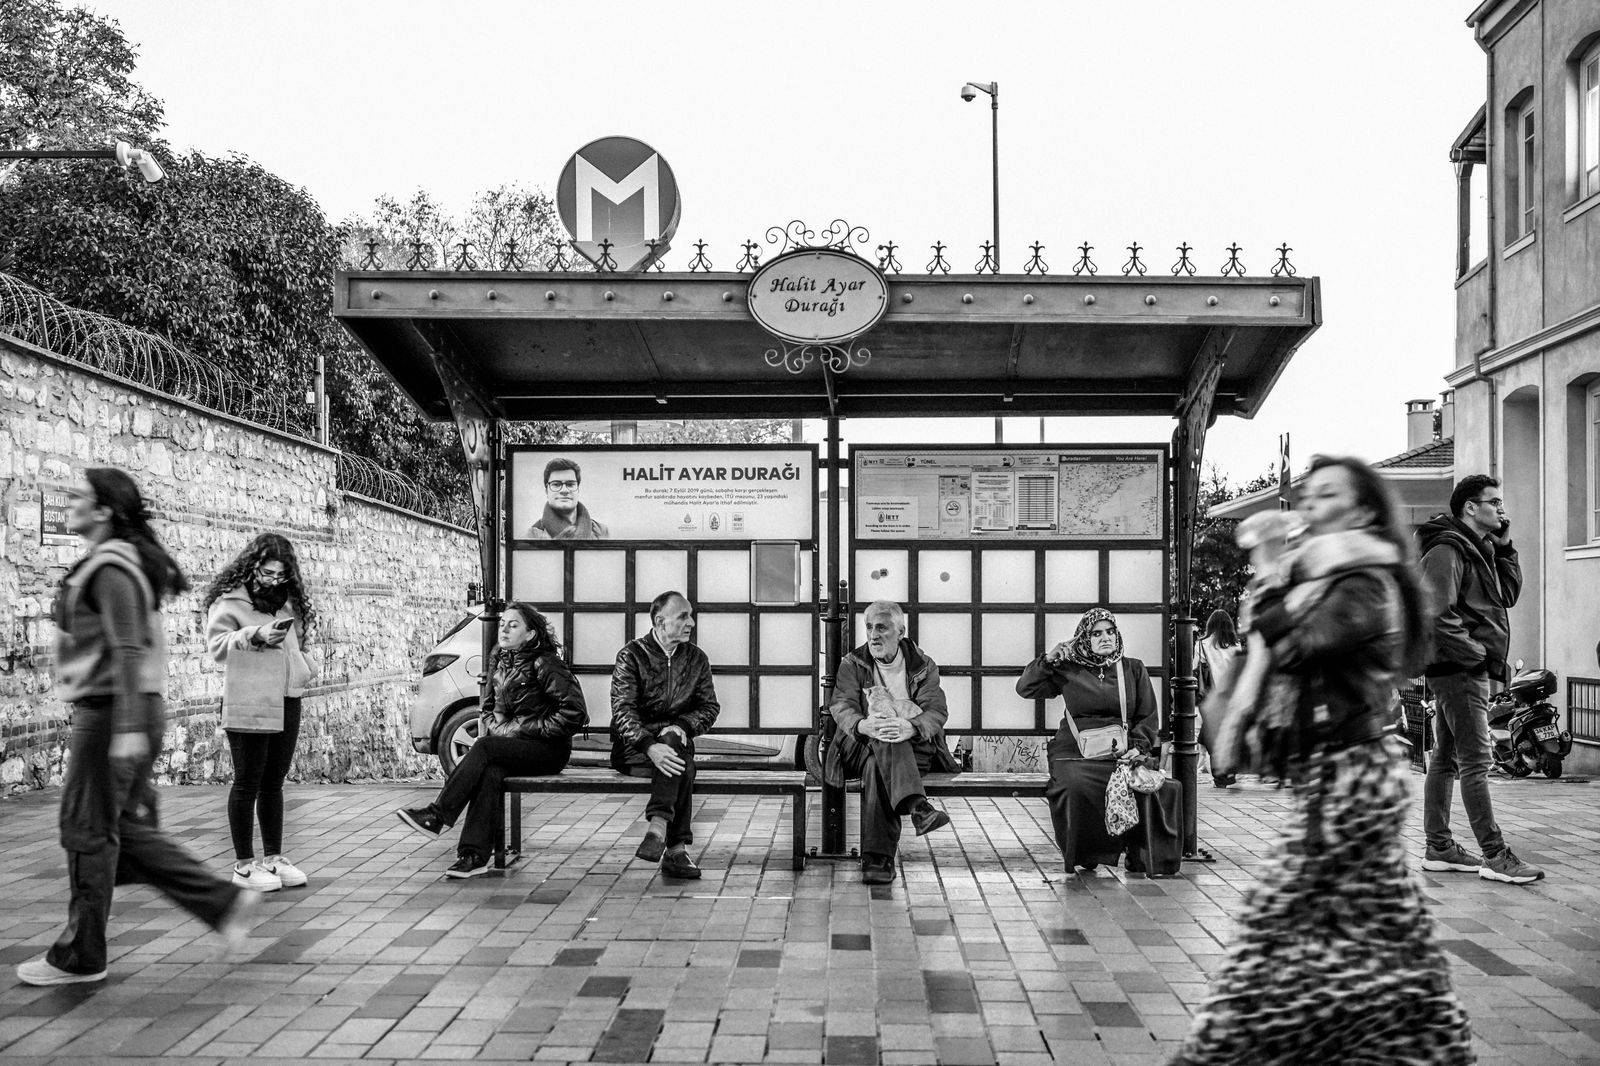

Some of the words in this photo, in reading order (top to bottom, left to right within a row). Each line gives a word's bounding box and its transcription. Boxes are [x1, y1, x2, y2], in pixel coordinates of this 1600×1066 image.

[576, 152, 660, 242] M
[770, 276, 816, 293] Halit
[820, 278, 866, 296] Ayar
[784, 298, 845, 317] Durağı
[622, 463, 675, 481] HALİT
[678, 467, 727, 481] AYAR
[731, 463, 801, 481] DURAĞI
